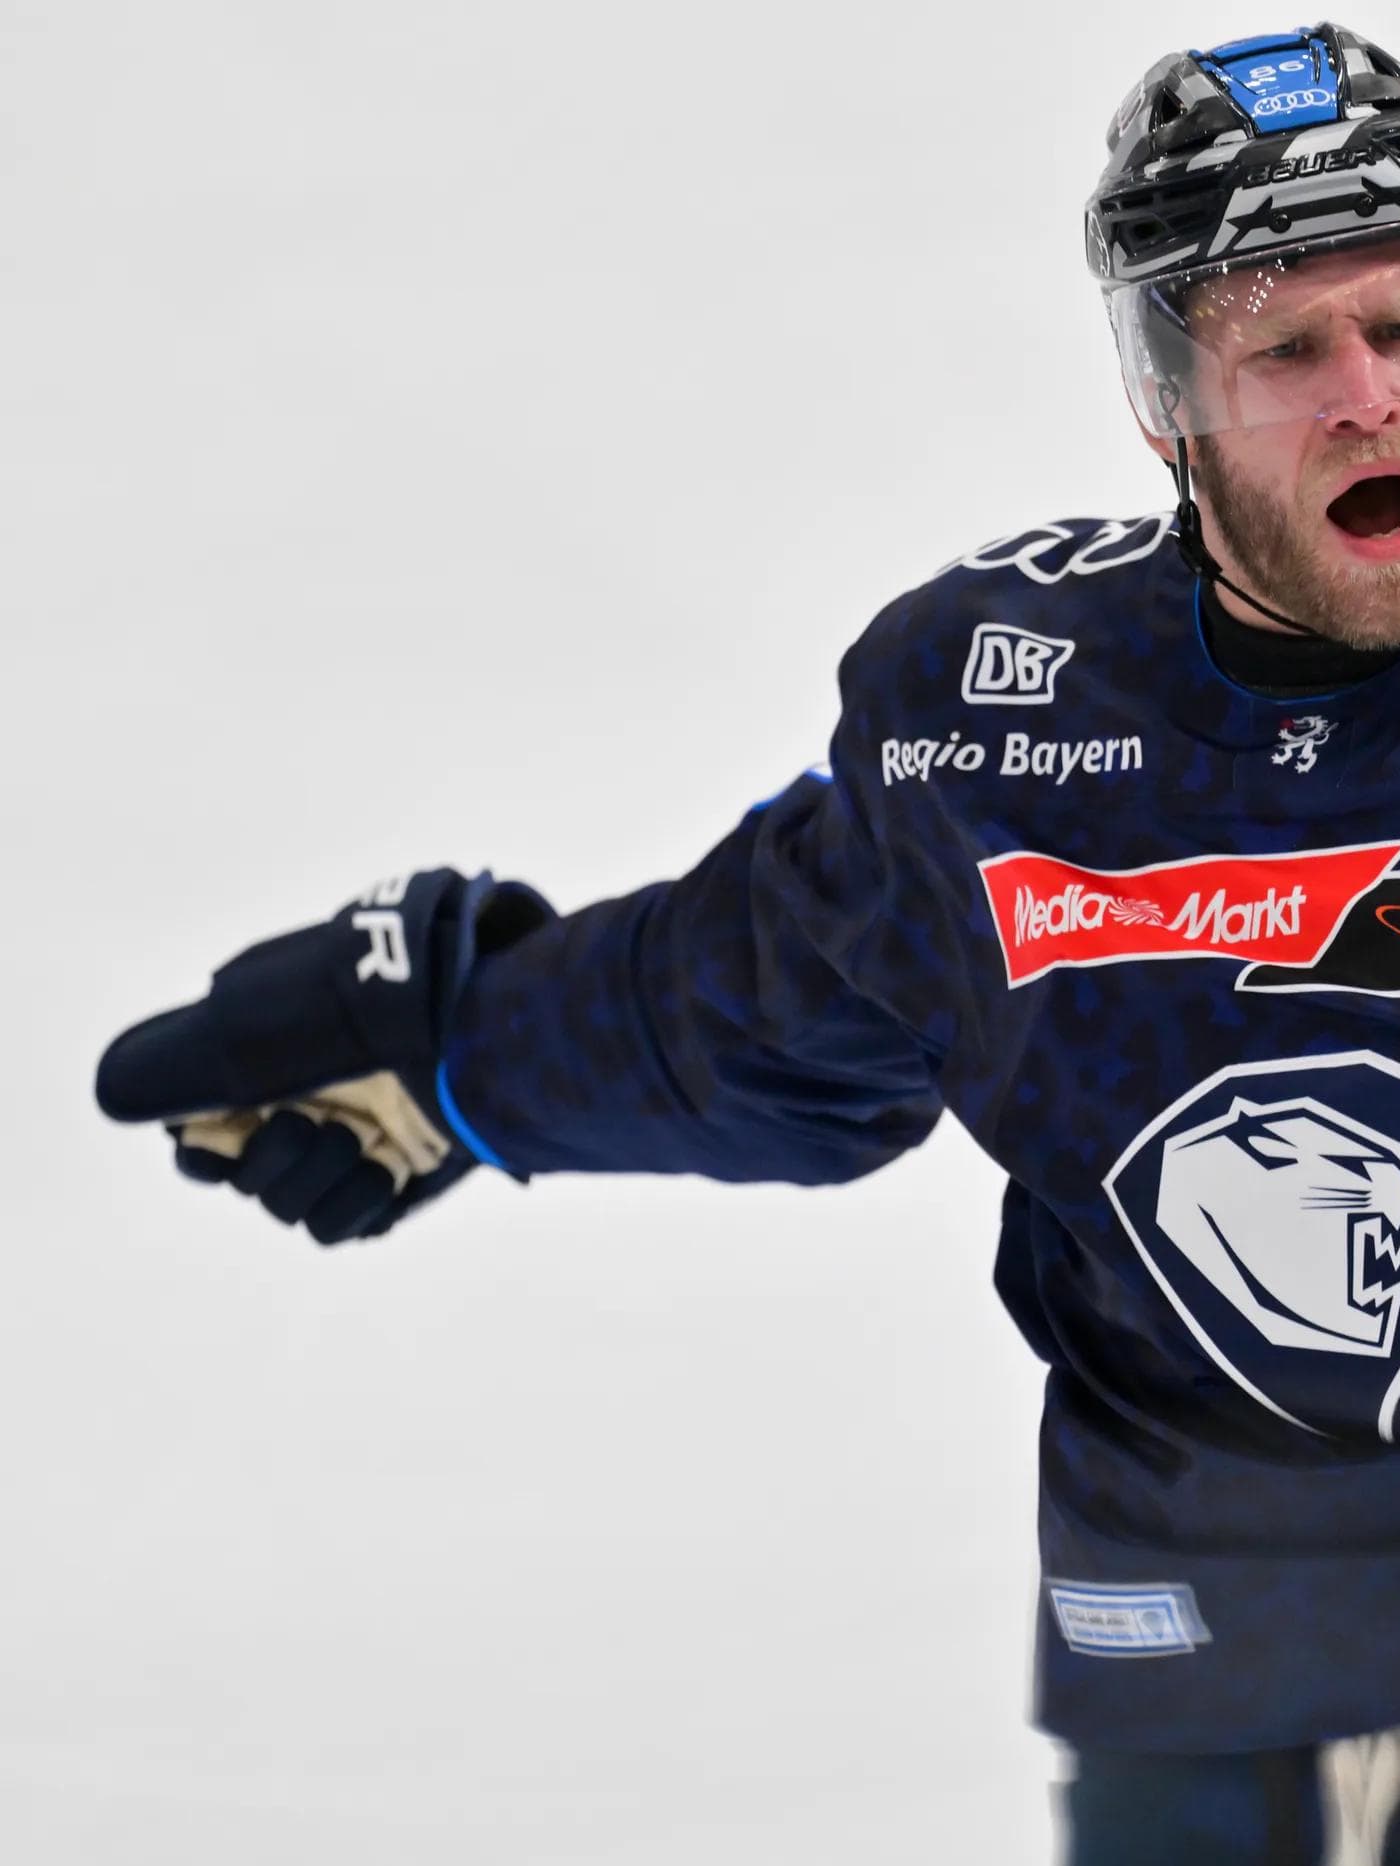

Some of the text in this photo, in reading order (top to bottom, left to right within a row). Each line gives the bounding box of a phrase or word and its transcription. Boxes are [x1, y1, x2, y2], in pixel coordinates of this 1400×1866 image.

[1241, 147, 1377, 190] BAUER
[973, 635, 1053, 692] DB
[882, 730, 1143, 786] Regio Bayern
[1013, 883, 1306, 947] Media Markt
